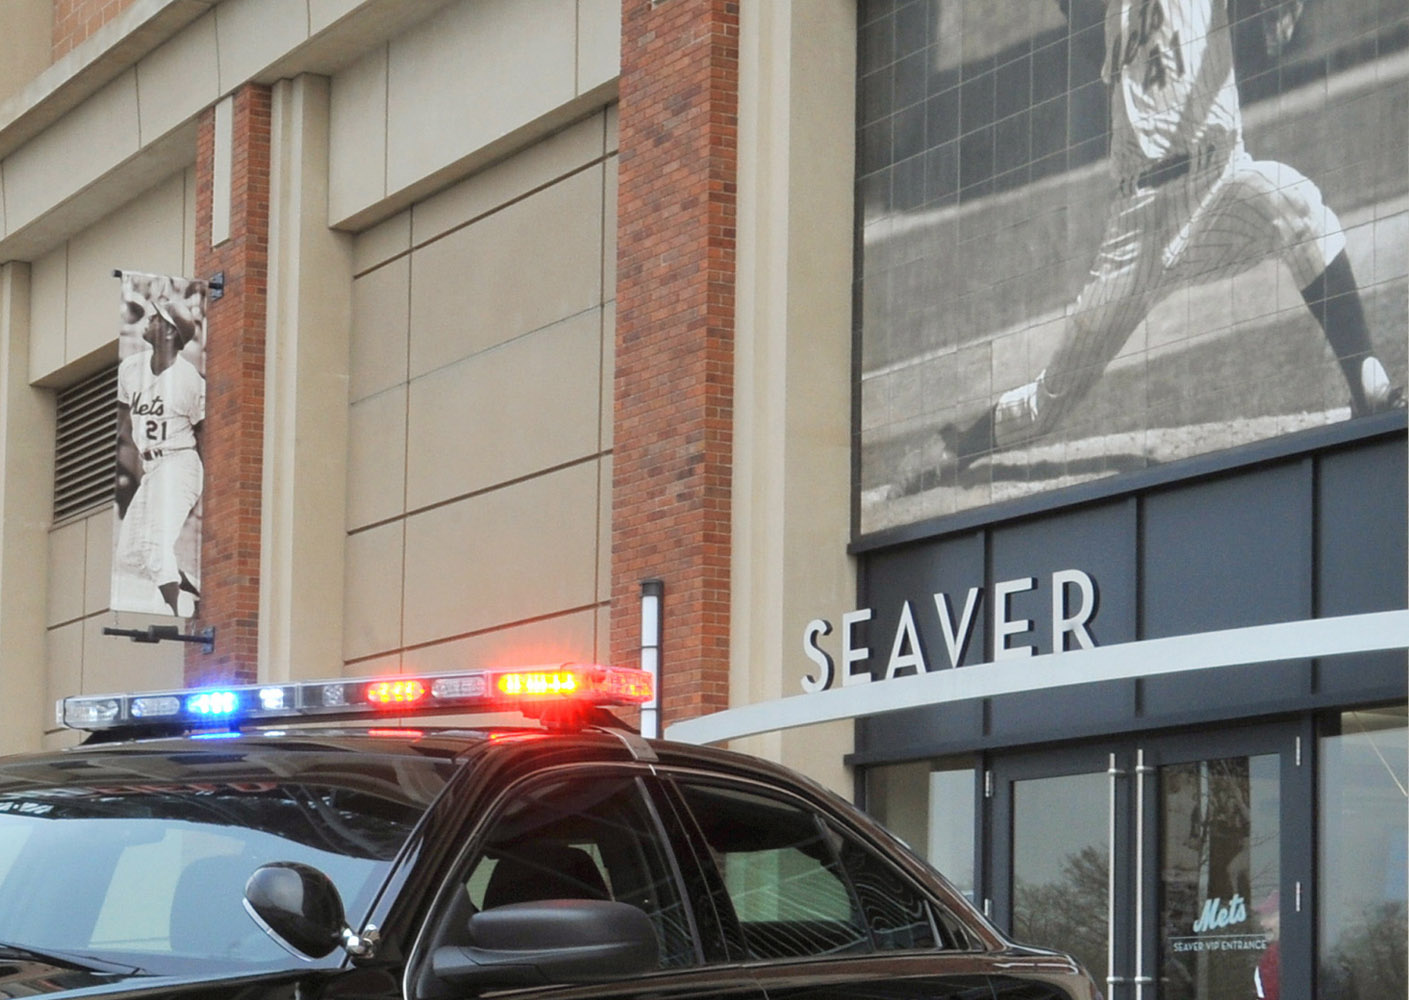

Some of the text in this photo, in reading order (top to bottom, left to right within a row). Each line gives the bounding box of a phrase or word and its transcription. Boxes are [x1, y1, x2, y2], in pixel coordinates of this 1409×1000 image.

[145, 420, 167, 441] 21
[800, 568, 1099, 693] SEAVER
[1193, 893, 1246, 932] Mets
[1173, 939, 1268, 952] SEAVER VIP ENTRANCE
